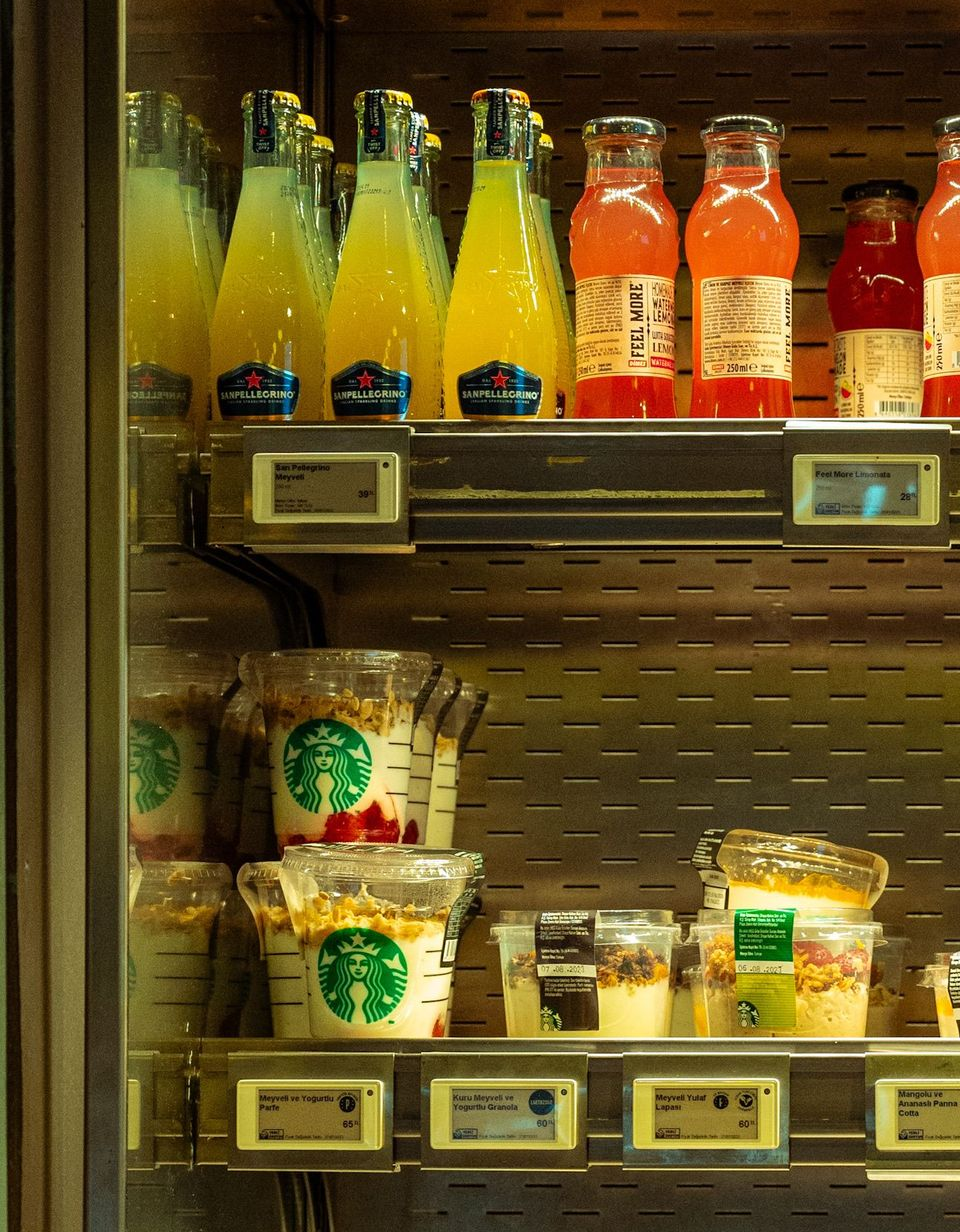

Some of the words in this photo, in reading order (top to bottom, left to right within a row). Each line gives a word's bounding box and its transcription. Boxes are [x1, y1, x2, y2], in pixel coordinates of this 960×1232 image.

[630, 283, 643, 321] MORE
[631, 327, 644, 358] FEEL
[221, 391, 294, 399] SANPELLEGRINO
[334, 391, 405, 400] SANPELLEGRINO
[462, 391, 539, 400] SANPELLEGRINO
[292, 465, 330, 473] Pellegrino
[358, 490, 368, 498] 39
[901, 493, 911, 501] 28
[474, 1094, 503, 1102] Meyveli
[898, 1091, 932, 1099] Mangolu
[343, 1120, 353, 1128] 65
[739, 1120, 749, 1128] 60
